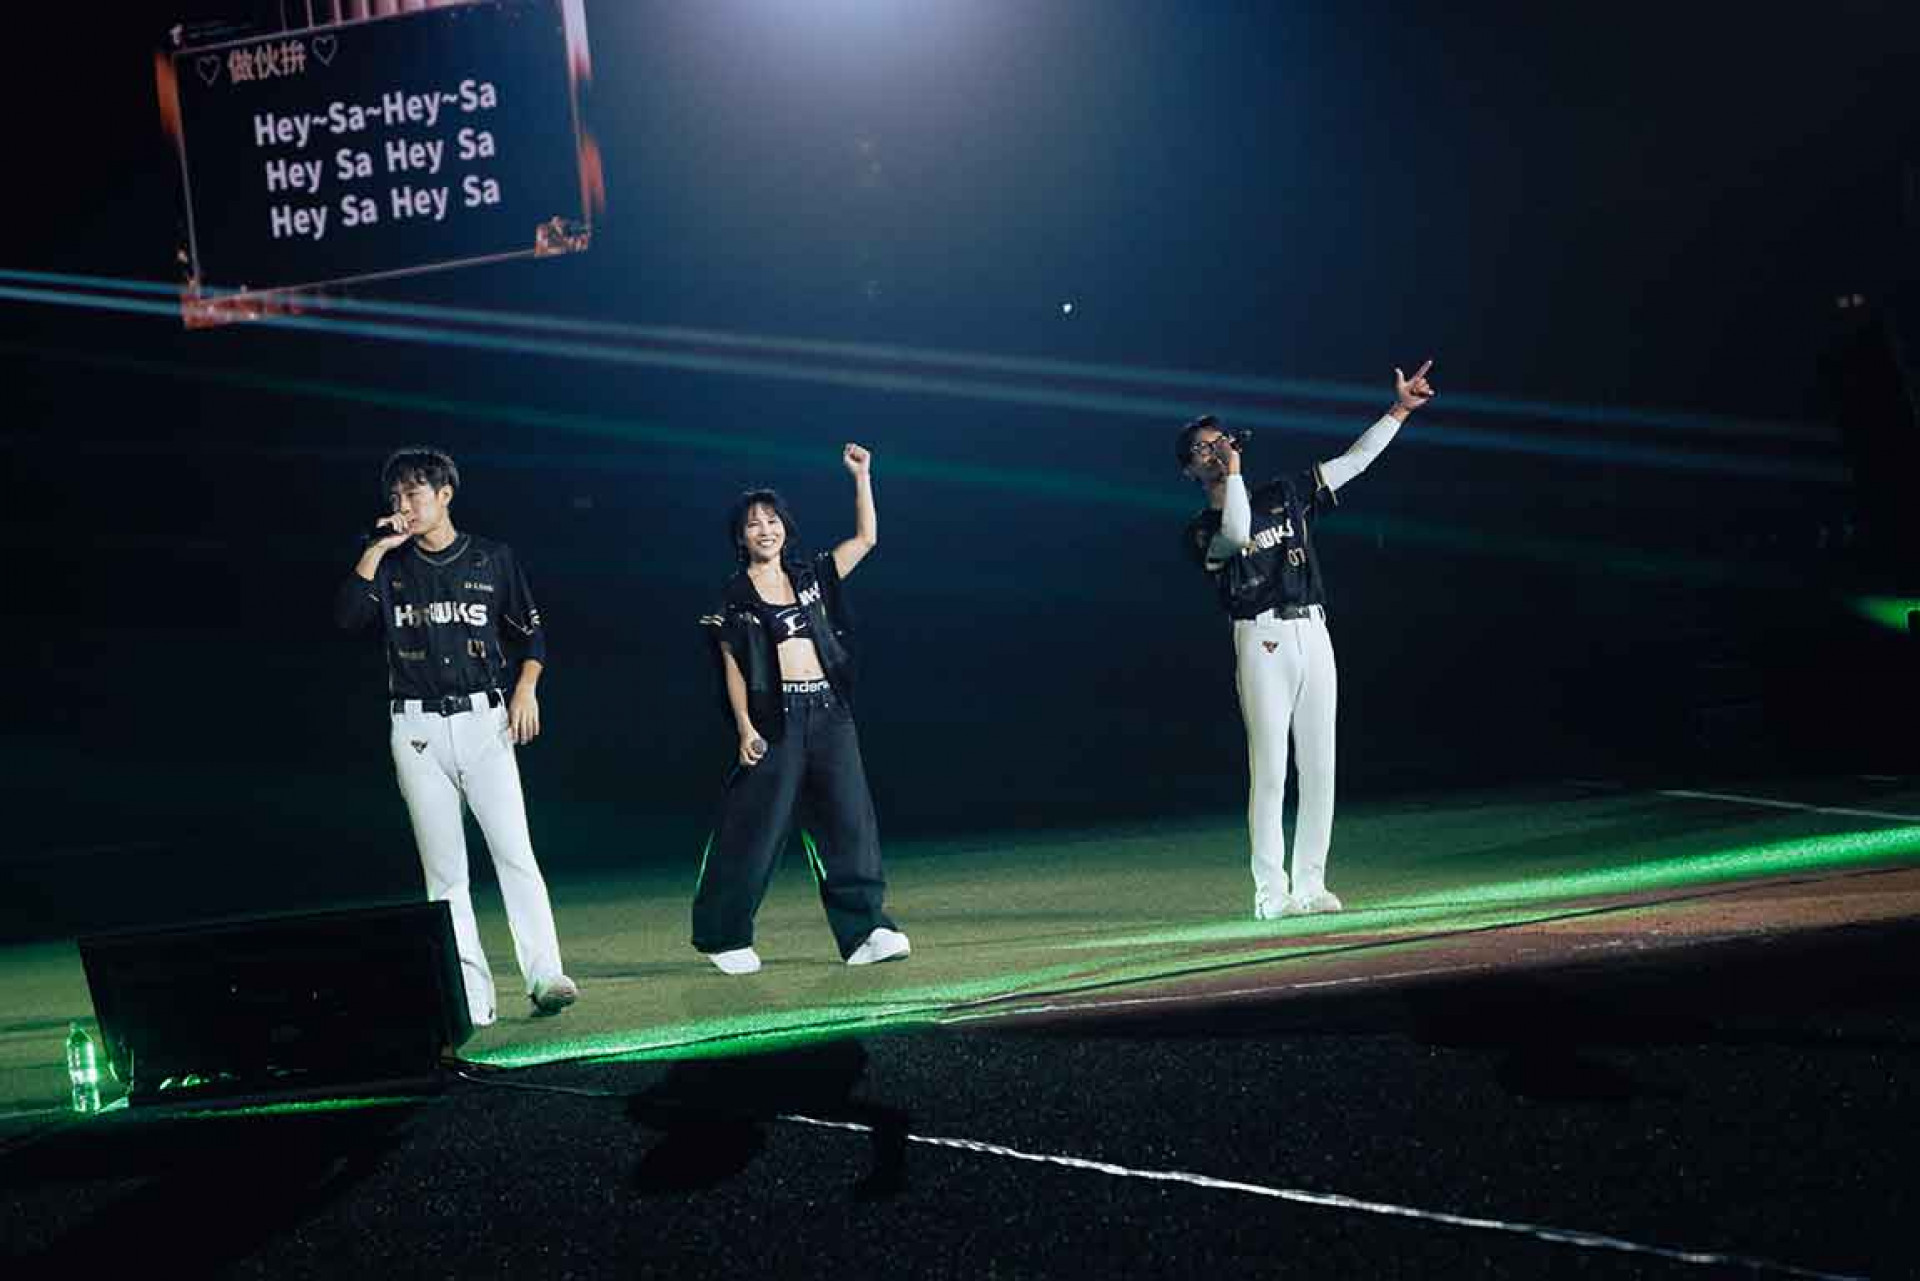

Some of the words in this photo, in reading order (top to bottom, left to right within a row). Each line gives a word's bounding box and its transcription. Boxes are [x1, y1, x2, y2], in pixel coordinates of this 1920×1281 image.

[253, 79, 497, 149] Hey~Sa~Hey~Sa
[266, 157, 323, 194] Hey
[336, 148, 374, 181] Sa
[386, 139, 444, 175] Hey
[458, 127, 496, 161] Sa
[269, 204, 328, 242] Hey
[340, 196, 379, 228] Sa
[390, 186, 449, 223] Hey
[462, 175, 502, 208] Sa
